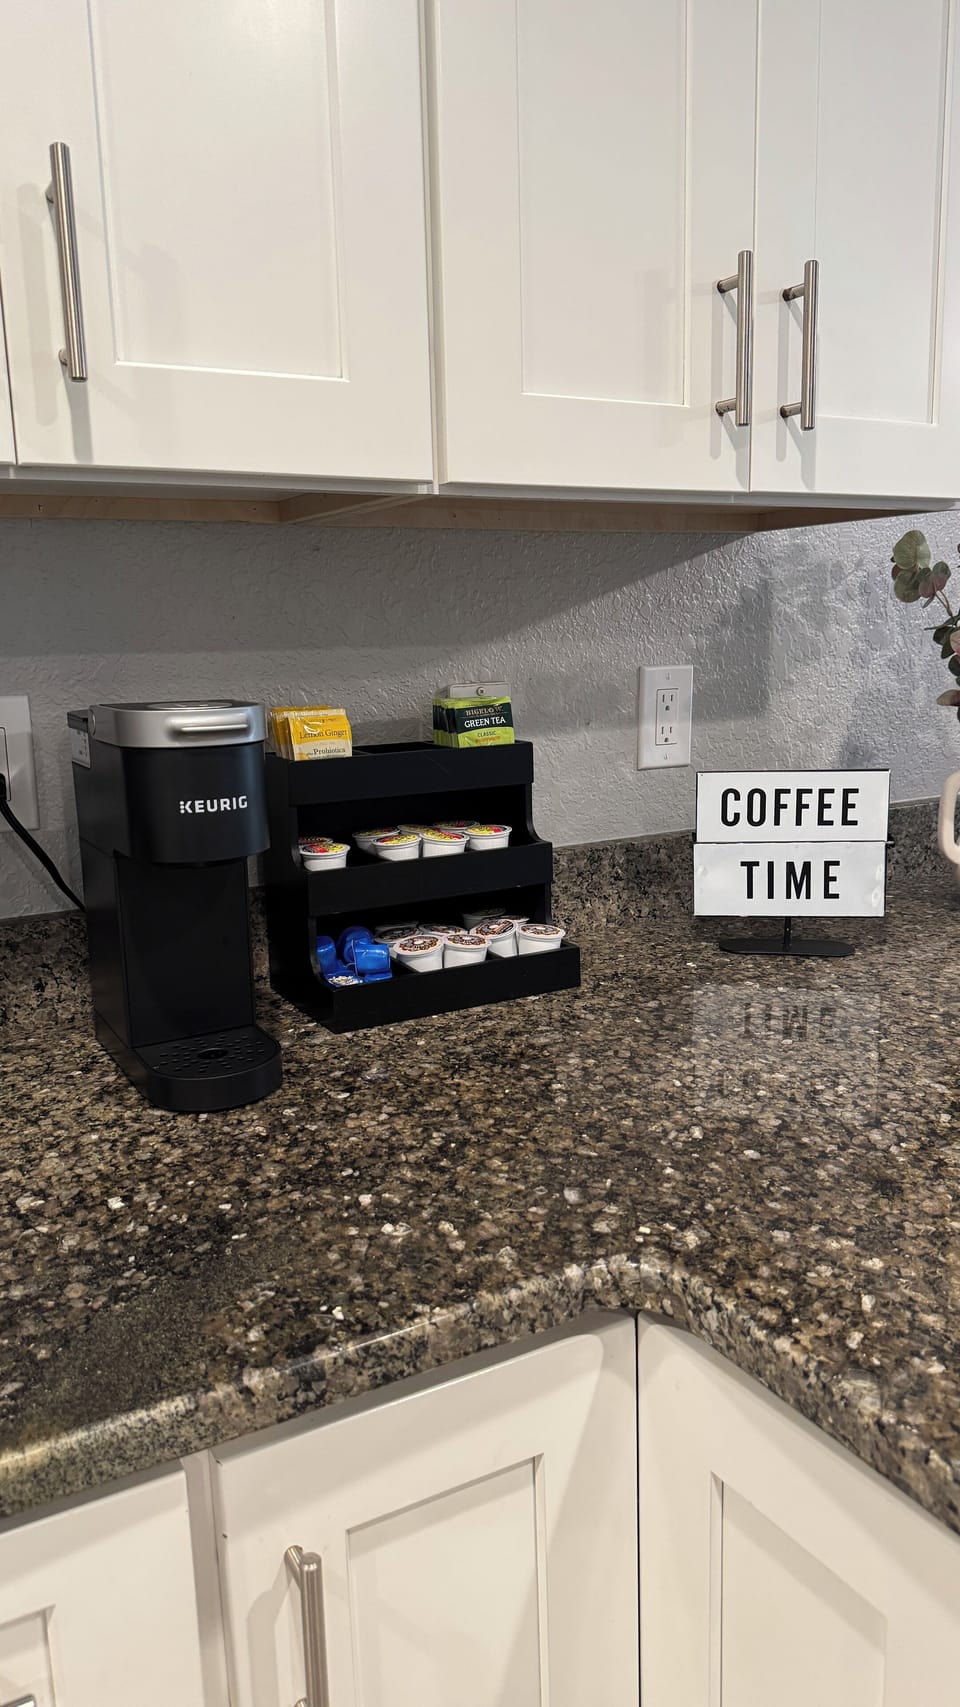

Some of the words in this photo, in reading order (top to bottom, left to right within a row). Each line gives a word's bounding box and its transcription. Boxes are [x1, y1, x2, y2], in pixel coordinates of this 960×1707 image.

[465, 705, 503, 716] BIGELOW
[464, 717, 490, 728] GREEN
[491, 716, 506, 725] TEA
[324, 729, 347, 738] Ginger
[477, 730, 497, 738] CLASSIC
[179, 795, 248, 814] KEURIG
[720, 787, 861, 828] COFFEE
[740, 860, 841, 900] TIME
